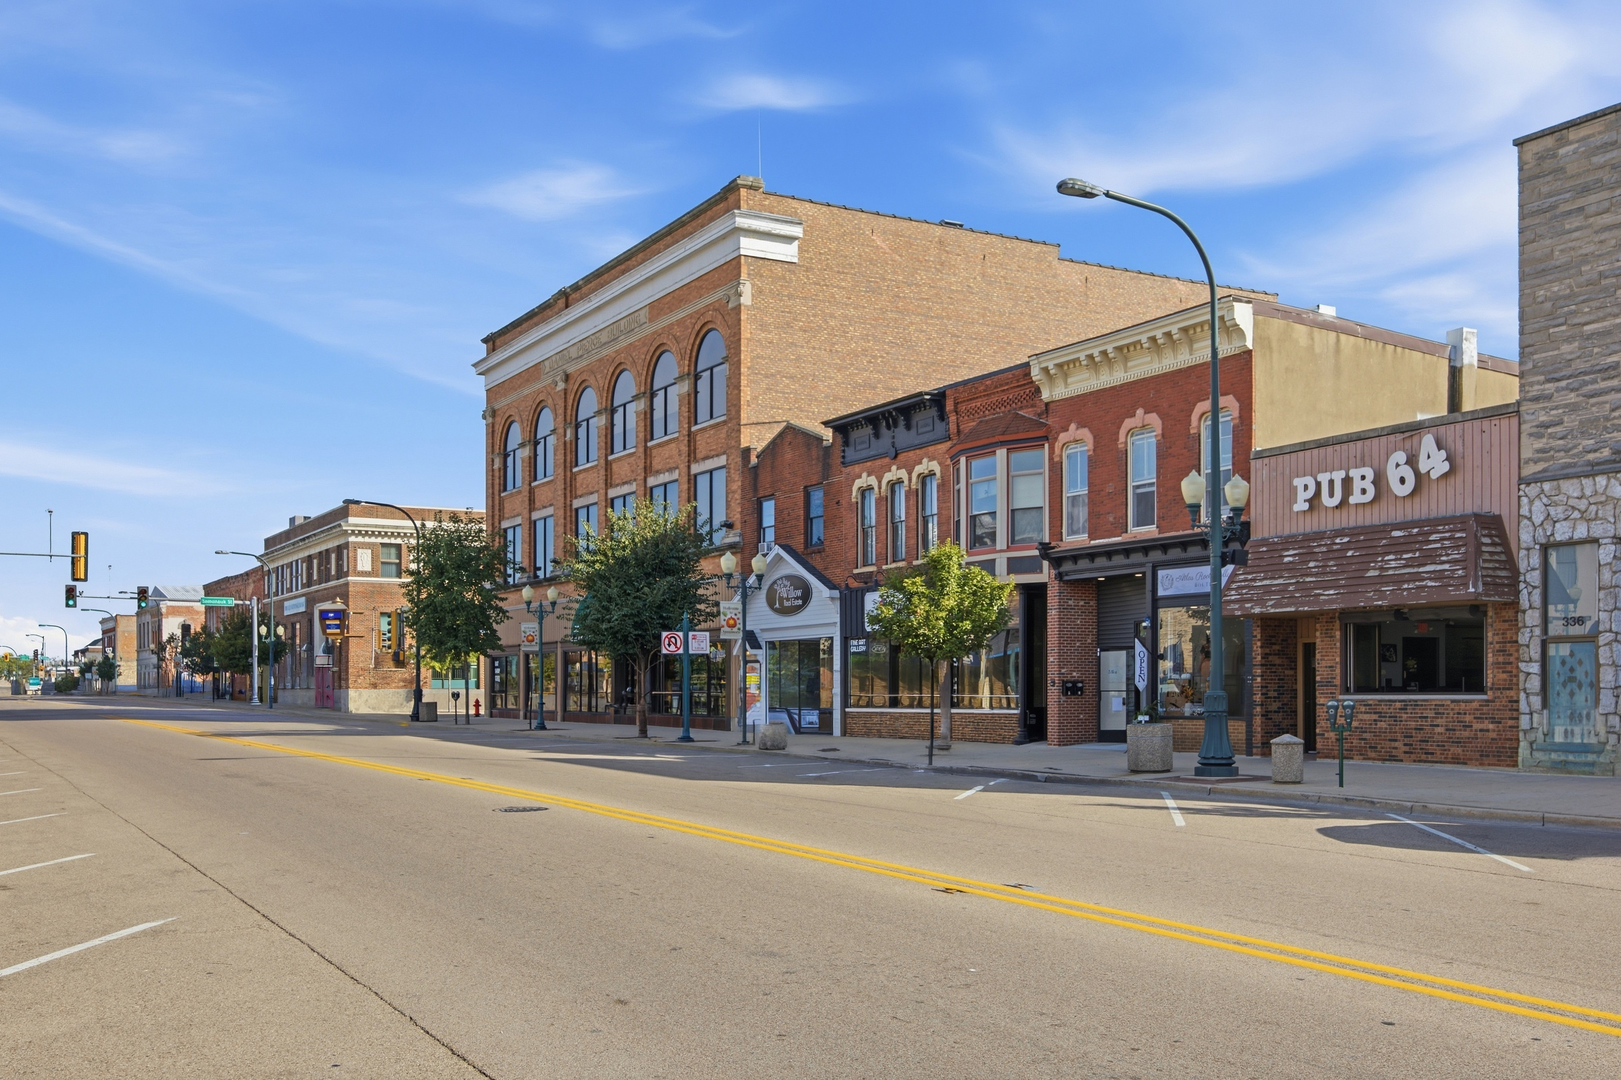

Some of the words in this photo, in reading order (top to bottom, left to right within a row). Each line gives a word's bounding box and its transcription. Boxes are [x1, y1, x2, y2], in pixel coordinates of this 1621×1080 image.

[607, 312, 641, 339] BUILDING
[1292, 466, 1376, 512] PUB
[1386, 433, 1450, 497] 64
[782, 586, 803, 598] Willow
[783, 599, 792, 607] Real
[792, 598, 803, 606] Estate
[1562, 616, 1585, 627] 336
[1137, 650, 1146, 683] OPEN
